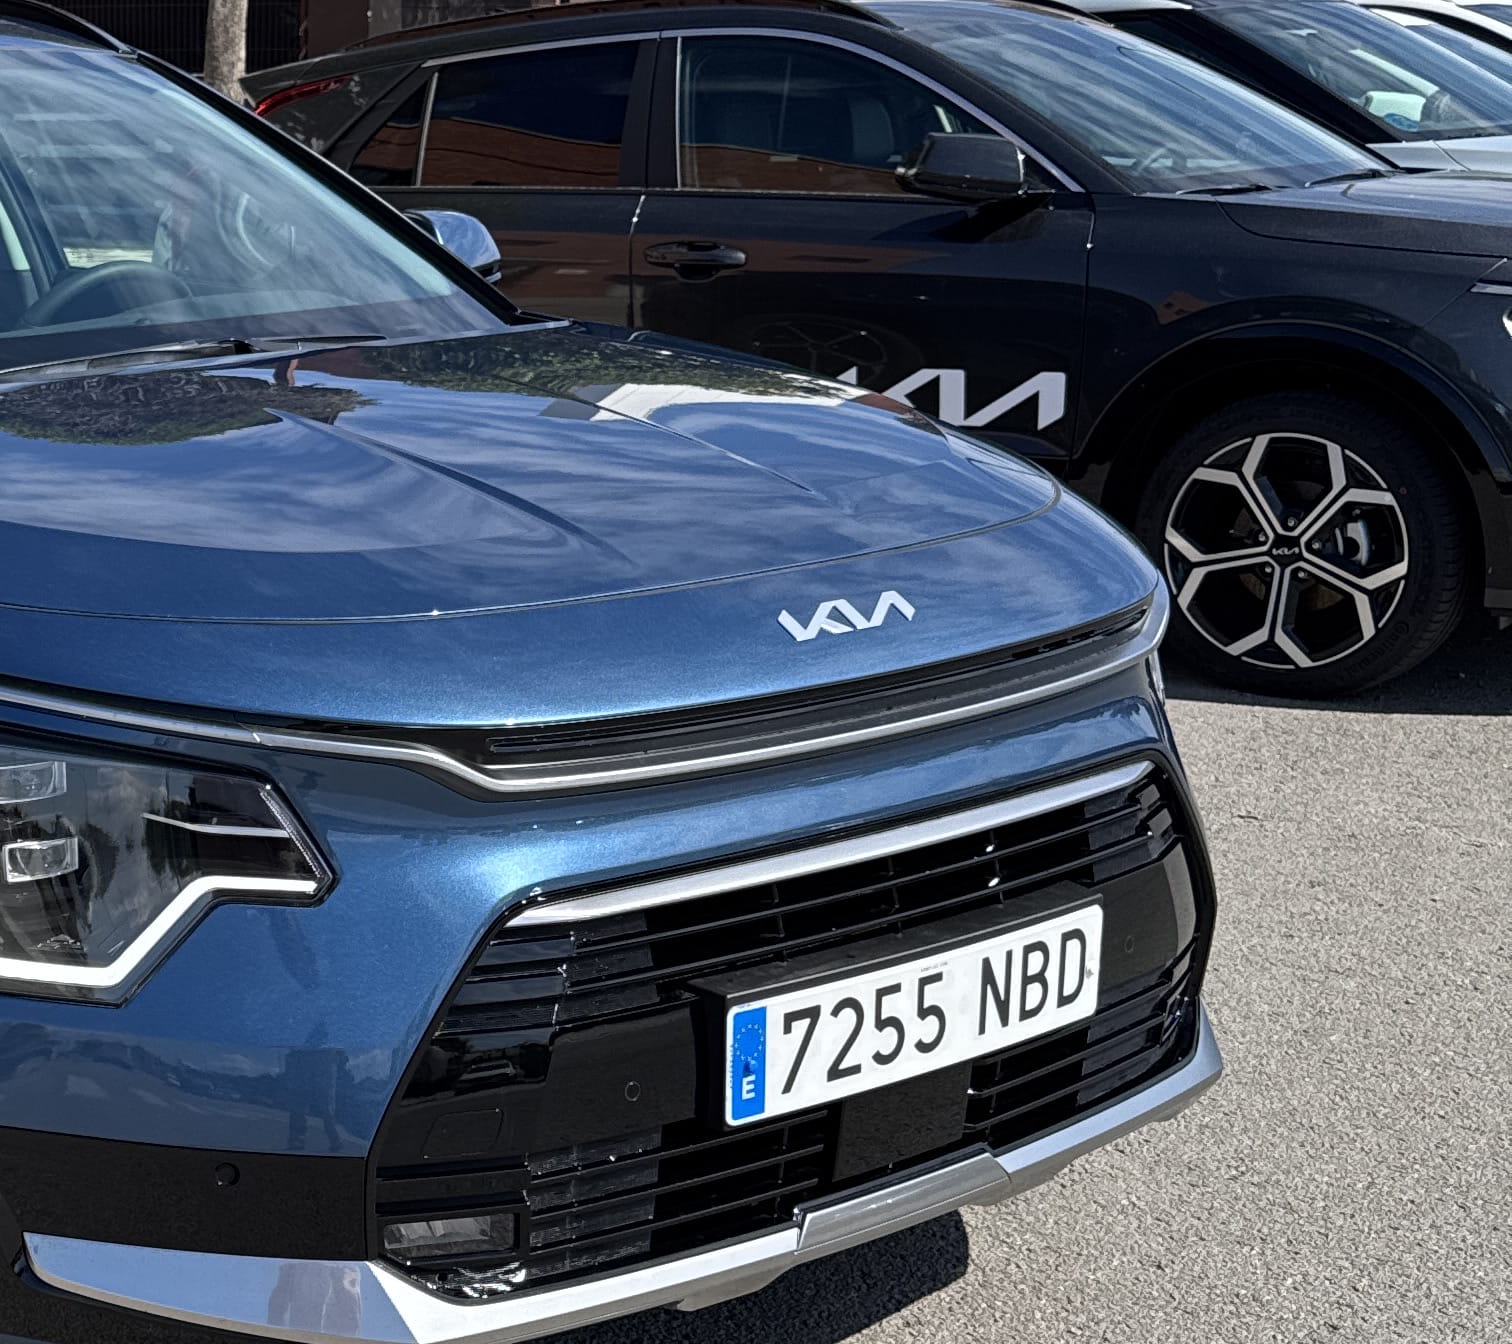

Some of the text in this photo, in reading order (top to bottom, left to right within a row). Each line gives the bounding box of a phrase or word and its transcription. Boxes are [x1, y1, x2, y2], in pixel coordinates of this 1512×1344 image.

[777, 590, 916, 642] KIA
[741, 1074, 756, 1100] E
[781, 971, 947, 1094] 7255
[978, 928, 1088, 1036] NBD
